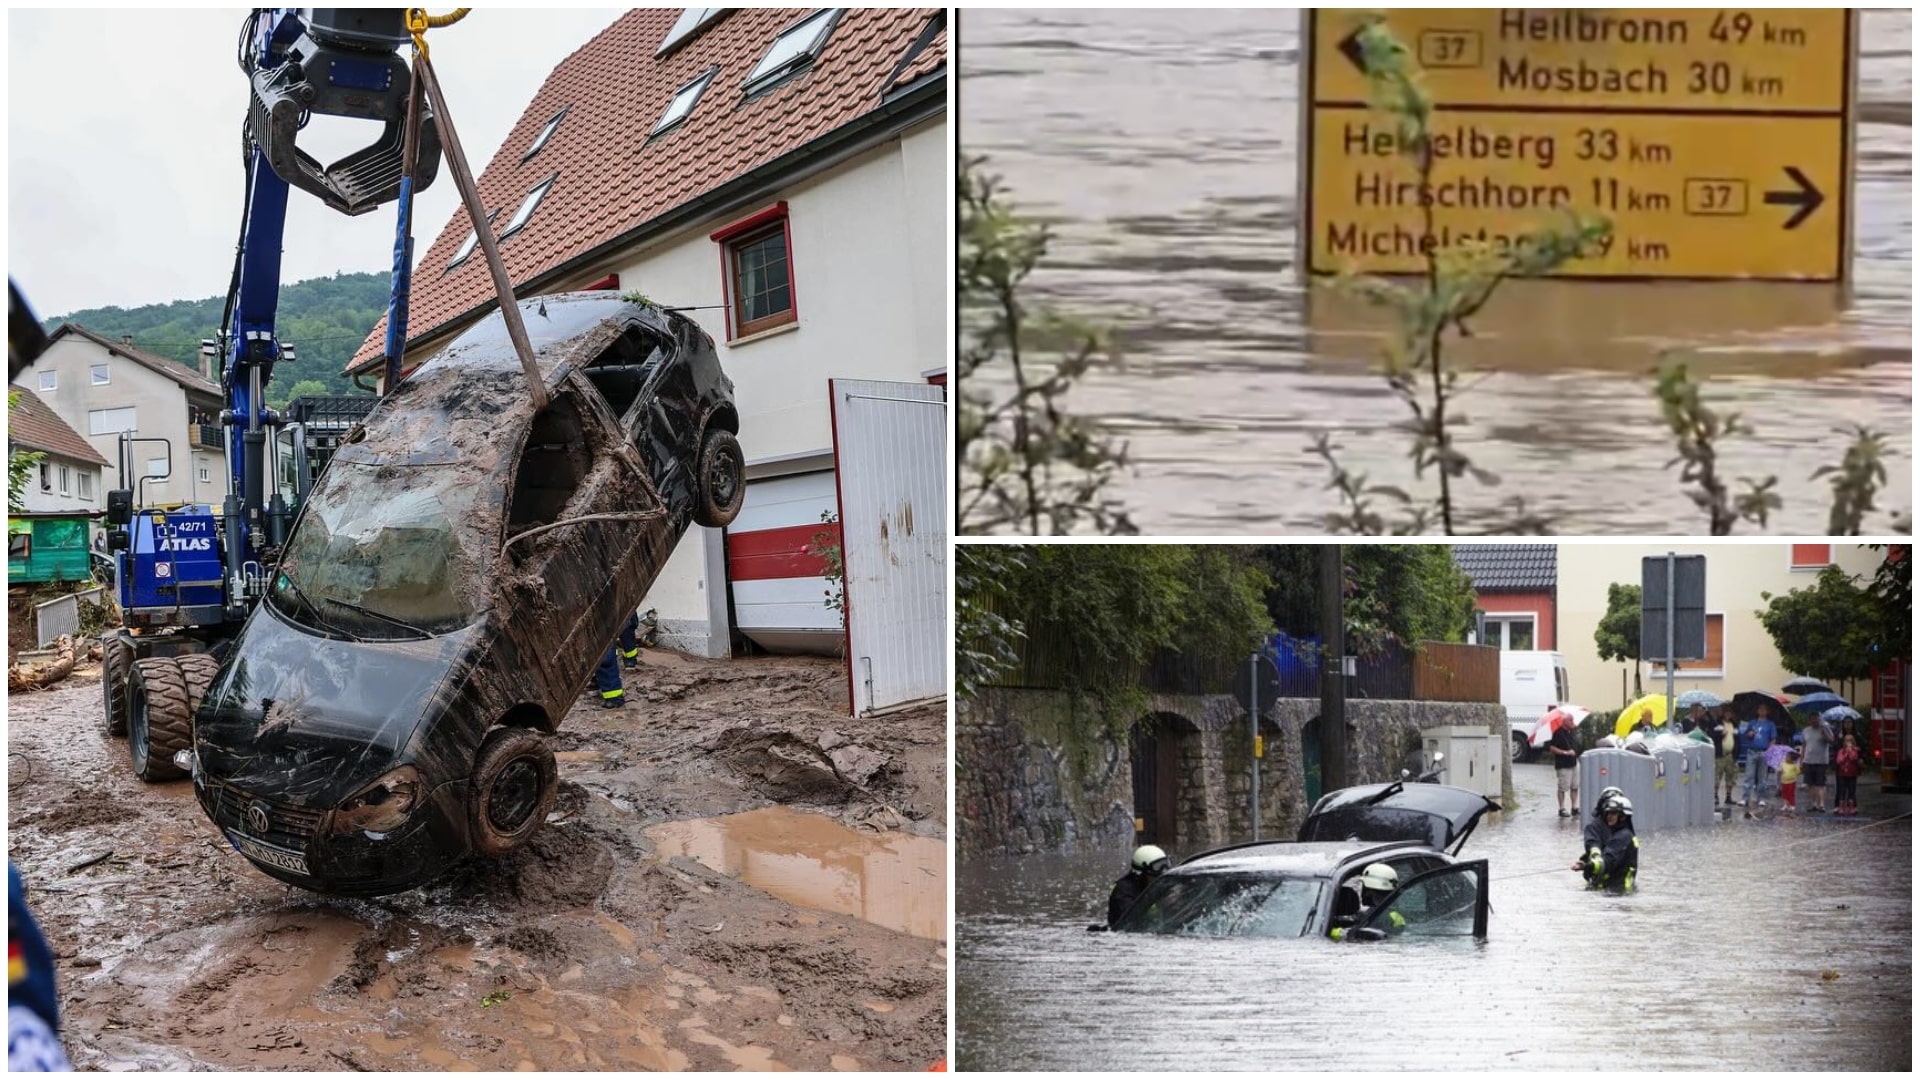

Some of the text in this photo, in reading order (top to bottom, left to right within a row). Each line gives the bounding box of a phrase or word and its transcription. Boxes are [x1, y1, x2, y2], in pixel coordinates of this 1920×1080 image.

[1499, 8, 1806, 47] Heilbronn 49 km
[1433, 37, 1466, 61] 37
[1499, 57, 1784, 97] Mosbach 30 km
[1574, 128, 1619, 162] 33
[1629, 139, 1672, 163] km
[1355, 172, 1731, 212] Hirschhorn 11 km 37
[1627, 237, 1670, 262] km
[178, 521, 206, 532] 42/71
[159, 538, 211, 551] ATLAS
